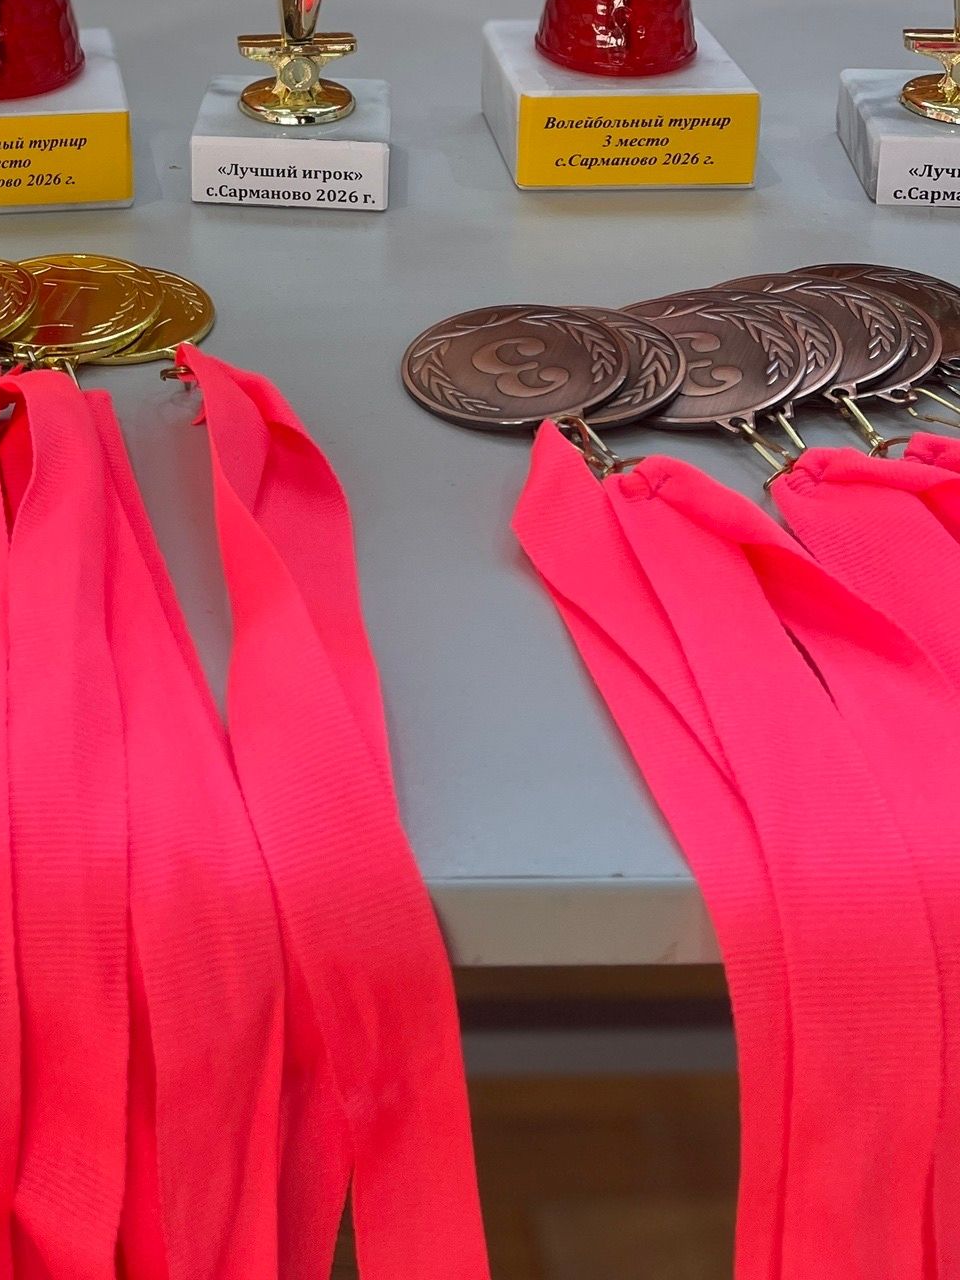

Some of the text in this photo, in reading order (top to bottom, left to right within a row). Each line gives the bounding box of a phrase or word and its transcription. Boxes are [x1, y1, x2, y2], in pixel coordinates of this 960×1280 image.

[543, 115, 732, 130] Волейбольный турнир
[28, 137, 88, 152] турнир
[602, 134, 670, 148] 3 место
[554, 152, 715, 169] с.Сарманово 2026 г.
[26, 173, 62, 187] 2026
[64, 175, 77, 185] г.
[217, 163, 363, 184] «Лучший игрок»
[206, 184, 376, 204] с.Сарманово 2026 г.
[471, 337, 570, 398] 3
